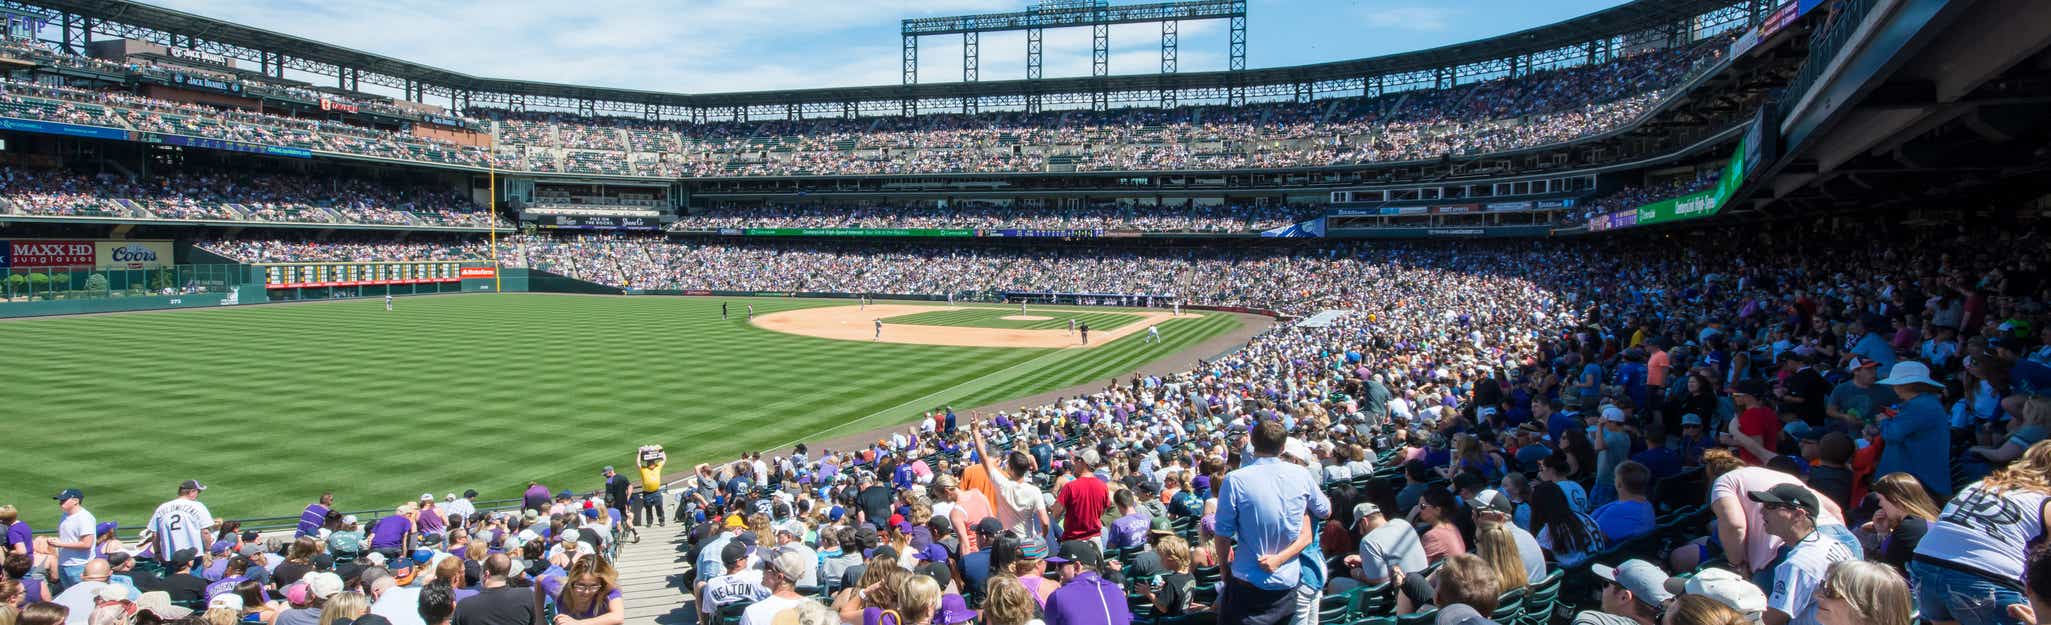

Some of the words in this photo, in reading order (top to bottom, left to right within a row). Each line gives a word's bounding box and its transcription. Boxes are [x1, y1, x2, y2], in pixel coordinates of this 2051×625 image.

[13, 244, 65, 256] MAXX
[69, 244, 93, 255] HD
[112, 246, 157, 262] Coors
[13, 255, 93, 263] sunglasses
[170, 514, 181, 531] 2
[711, 583, 752, 601] HELTON
